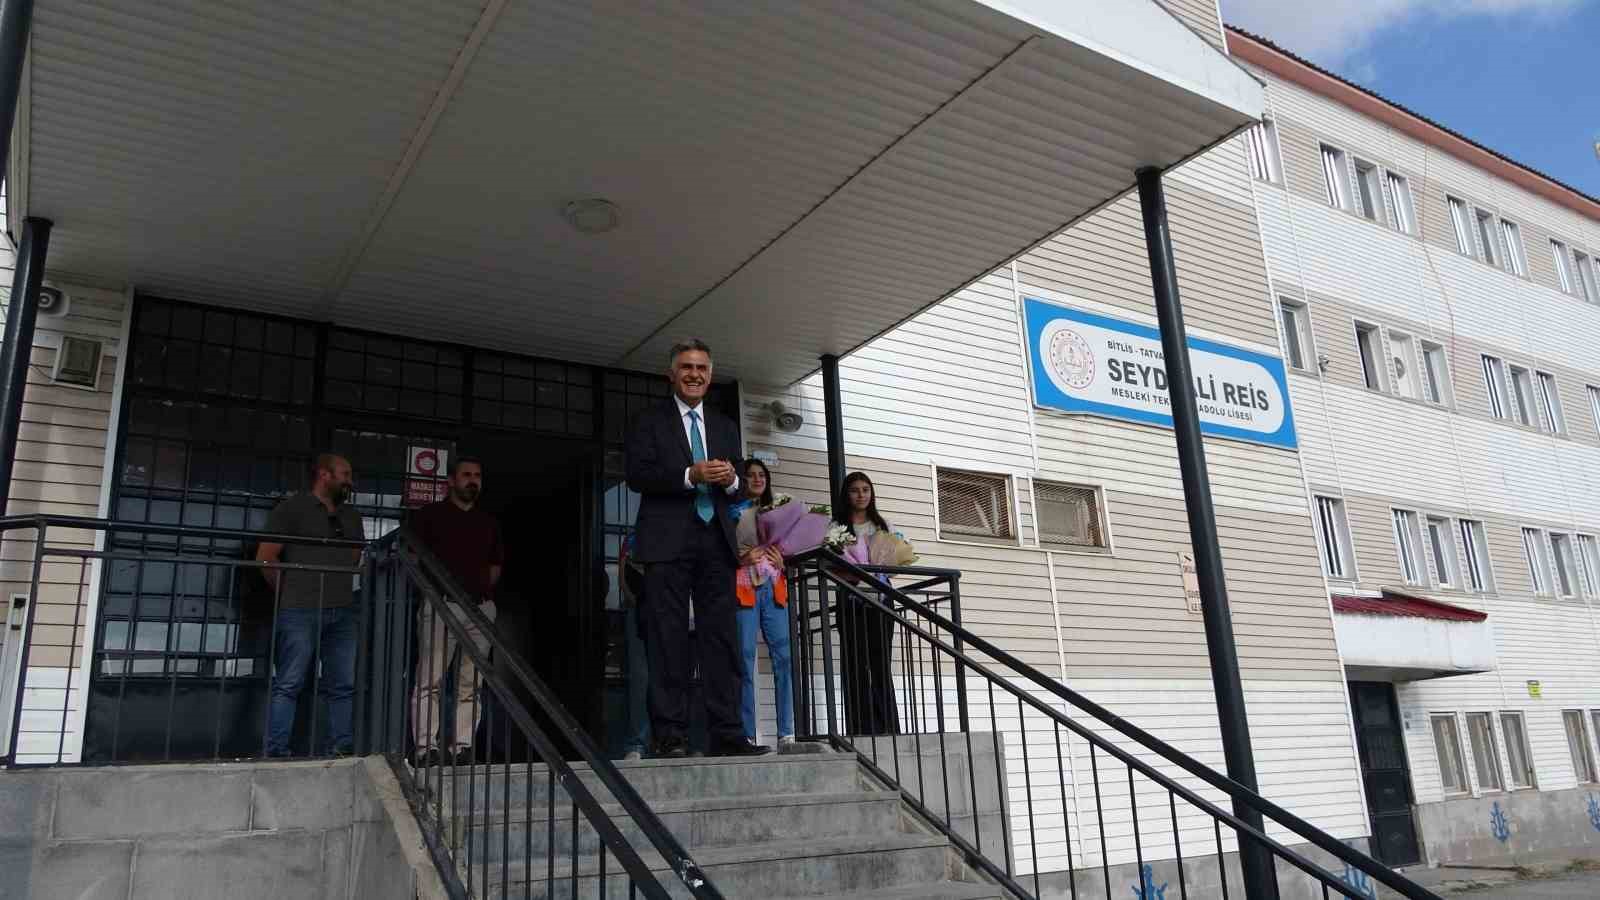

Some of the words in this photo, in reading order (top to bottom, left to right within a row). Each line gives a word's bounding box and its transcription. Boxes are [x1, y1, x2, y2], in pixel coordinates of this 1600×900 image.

[1139, 347, 1167, 361] TATVA
[1108, 358, 1169, 390] SEYD
[1223, 382, 1269, 411] REİS
[1111, 387, 1151, 402] MESLEKİ
